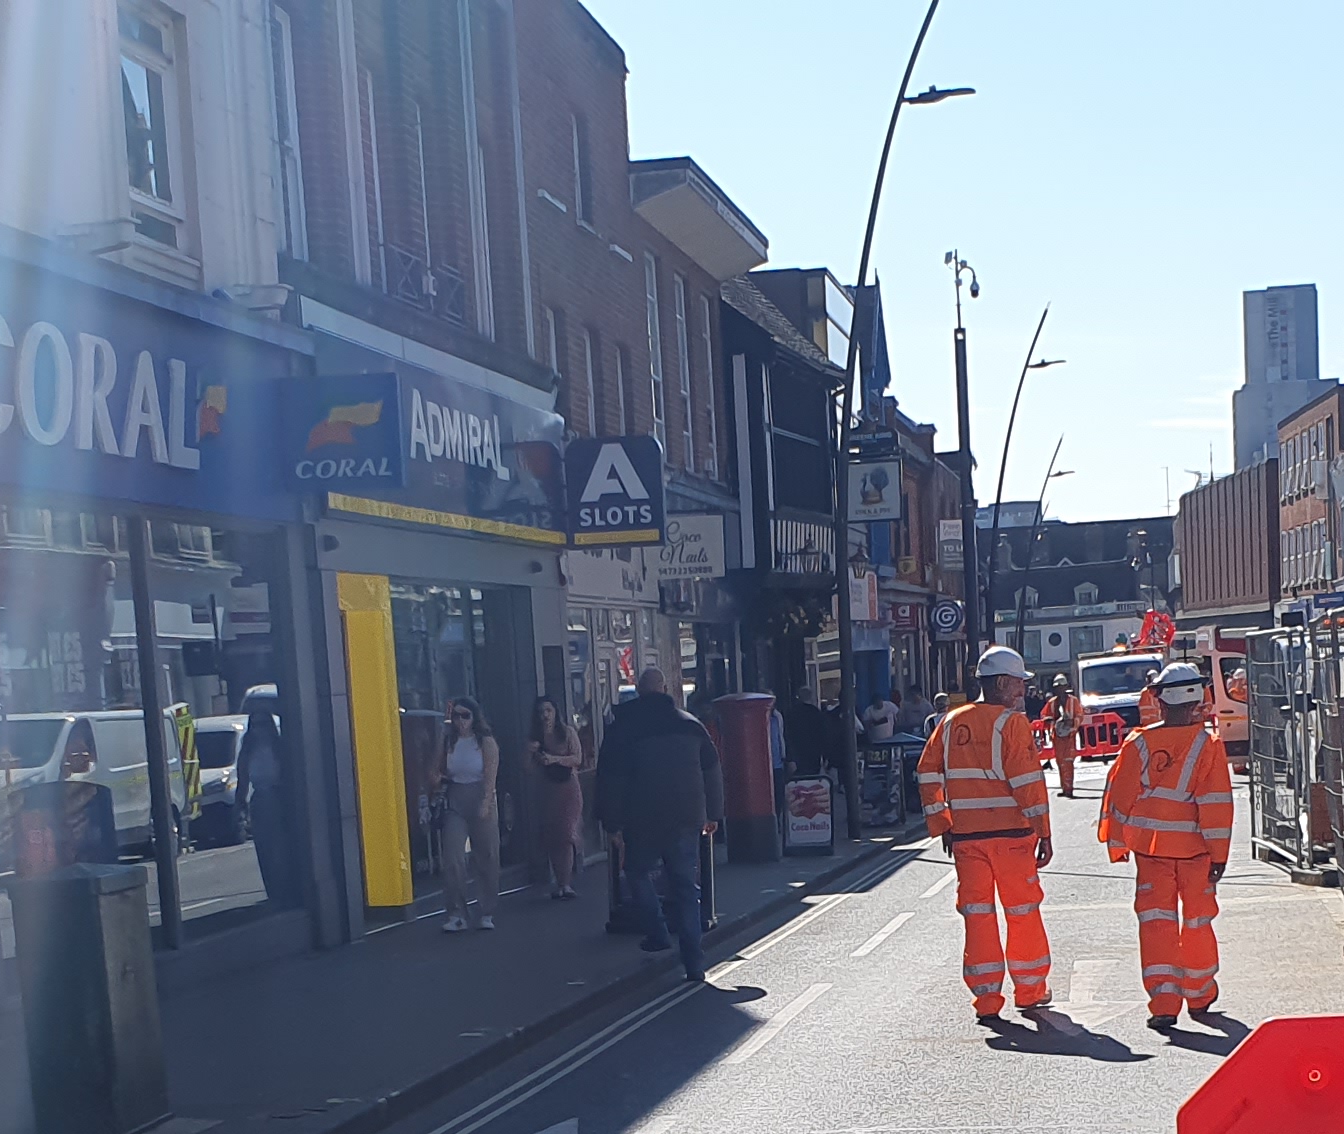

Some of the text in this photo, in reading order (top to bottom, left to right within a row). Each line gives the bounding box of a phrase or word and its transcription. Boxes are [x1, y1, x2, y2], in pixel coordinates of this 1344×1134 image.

[410, 388, 510, 481] ADMIRAL
[296, 457, 393, 479] CORAL
[580, 443, 650, 503] A
[580, 505, 652, 526] SLOTS
[667, 522, 701, 543] Coco
[660, 543, 708, 564] Nails
